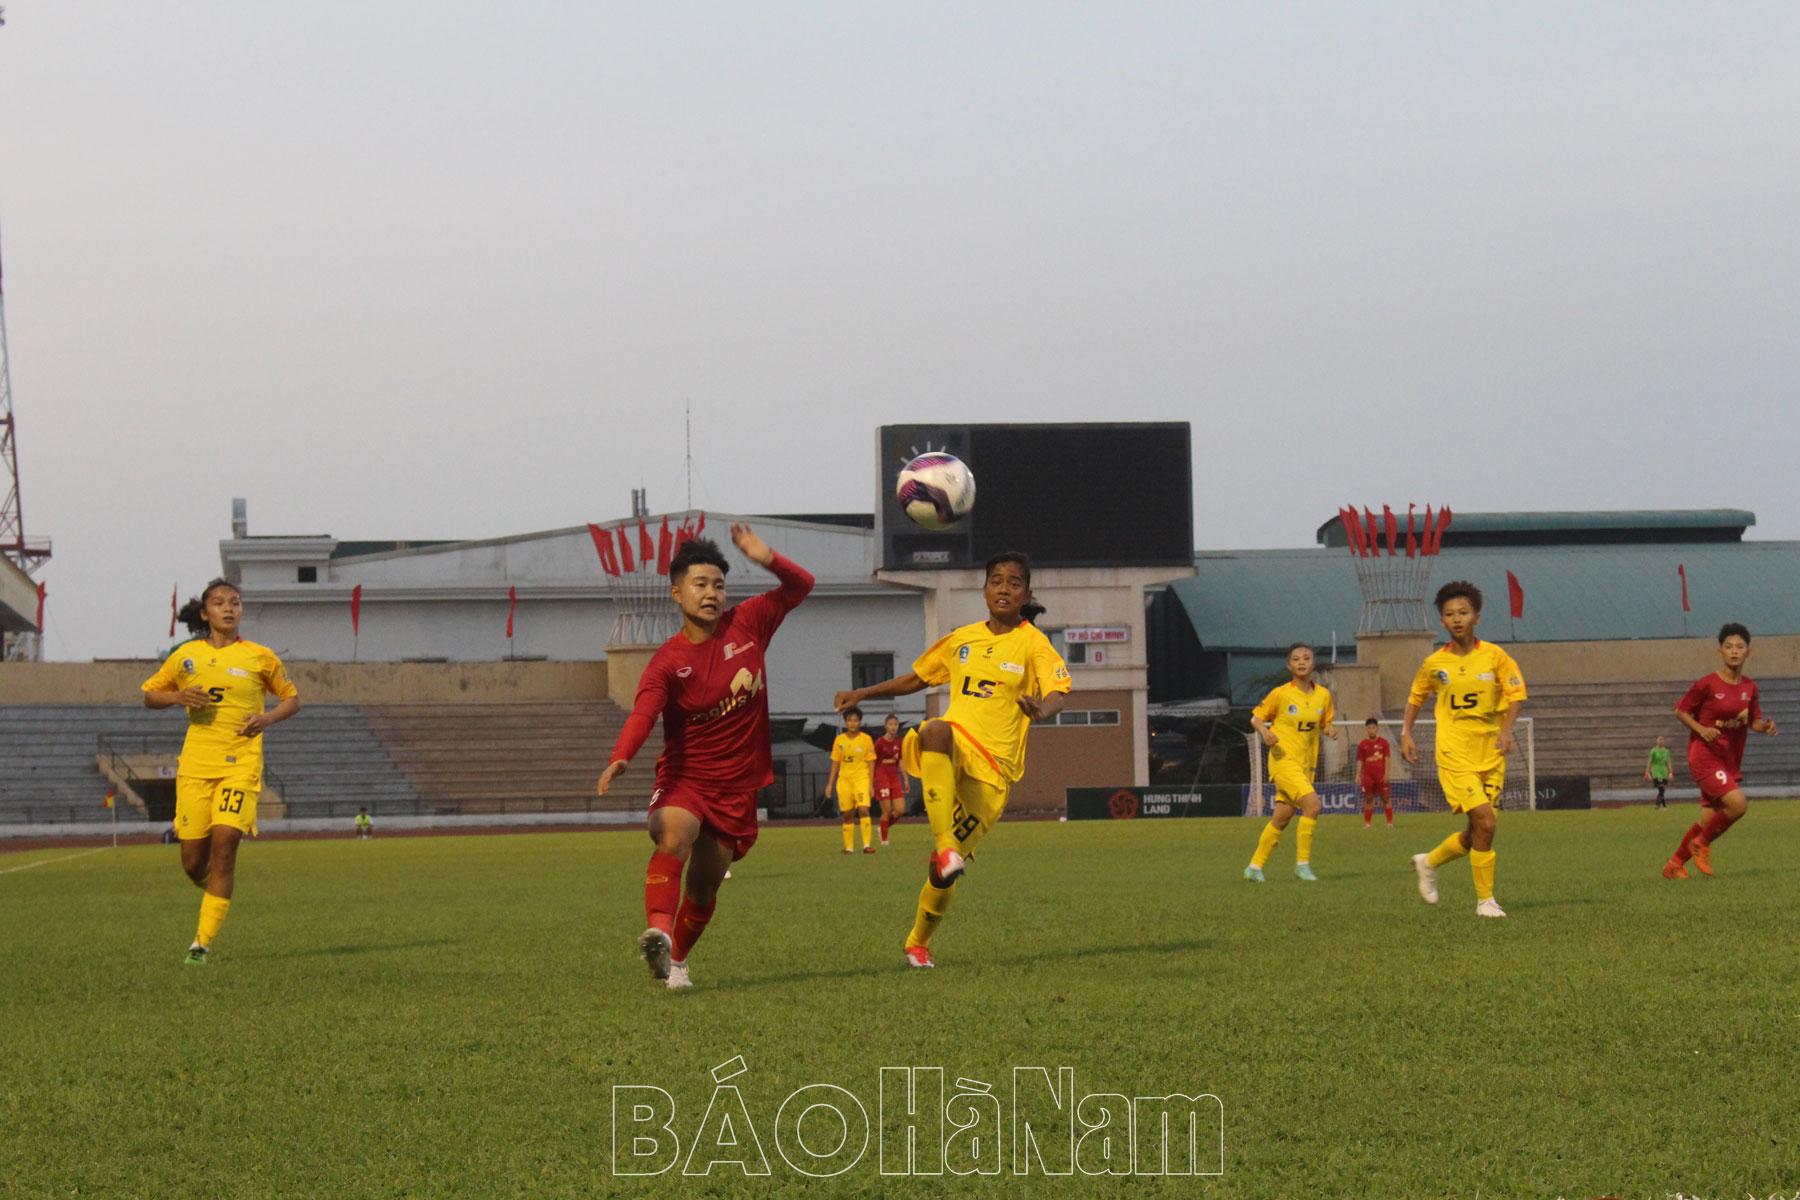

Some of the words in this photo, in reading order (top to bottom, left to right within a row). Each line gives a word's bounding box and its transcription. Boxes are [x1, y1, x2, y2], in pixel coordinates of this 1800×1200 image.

[961, 676, 997, 699] LS
[1450, 692, 1478, 710] LS
[1297, 721, 1316, 733] LS
[1715, 770, 1728, 785] 9
[219, 787, 245, 814] 33
[1143, 794, 1171, 803] HUNG
[1143, 804, 1170, 814] LAND
